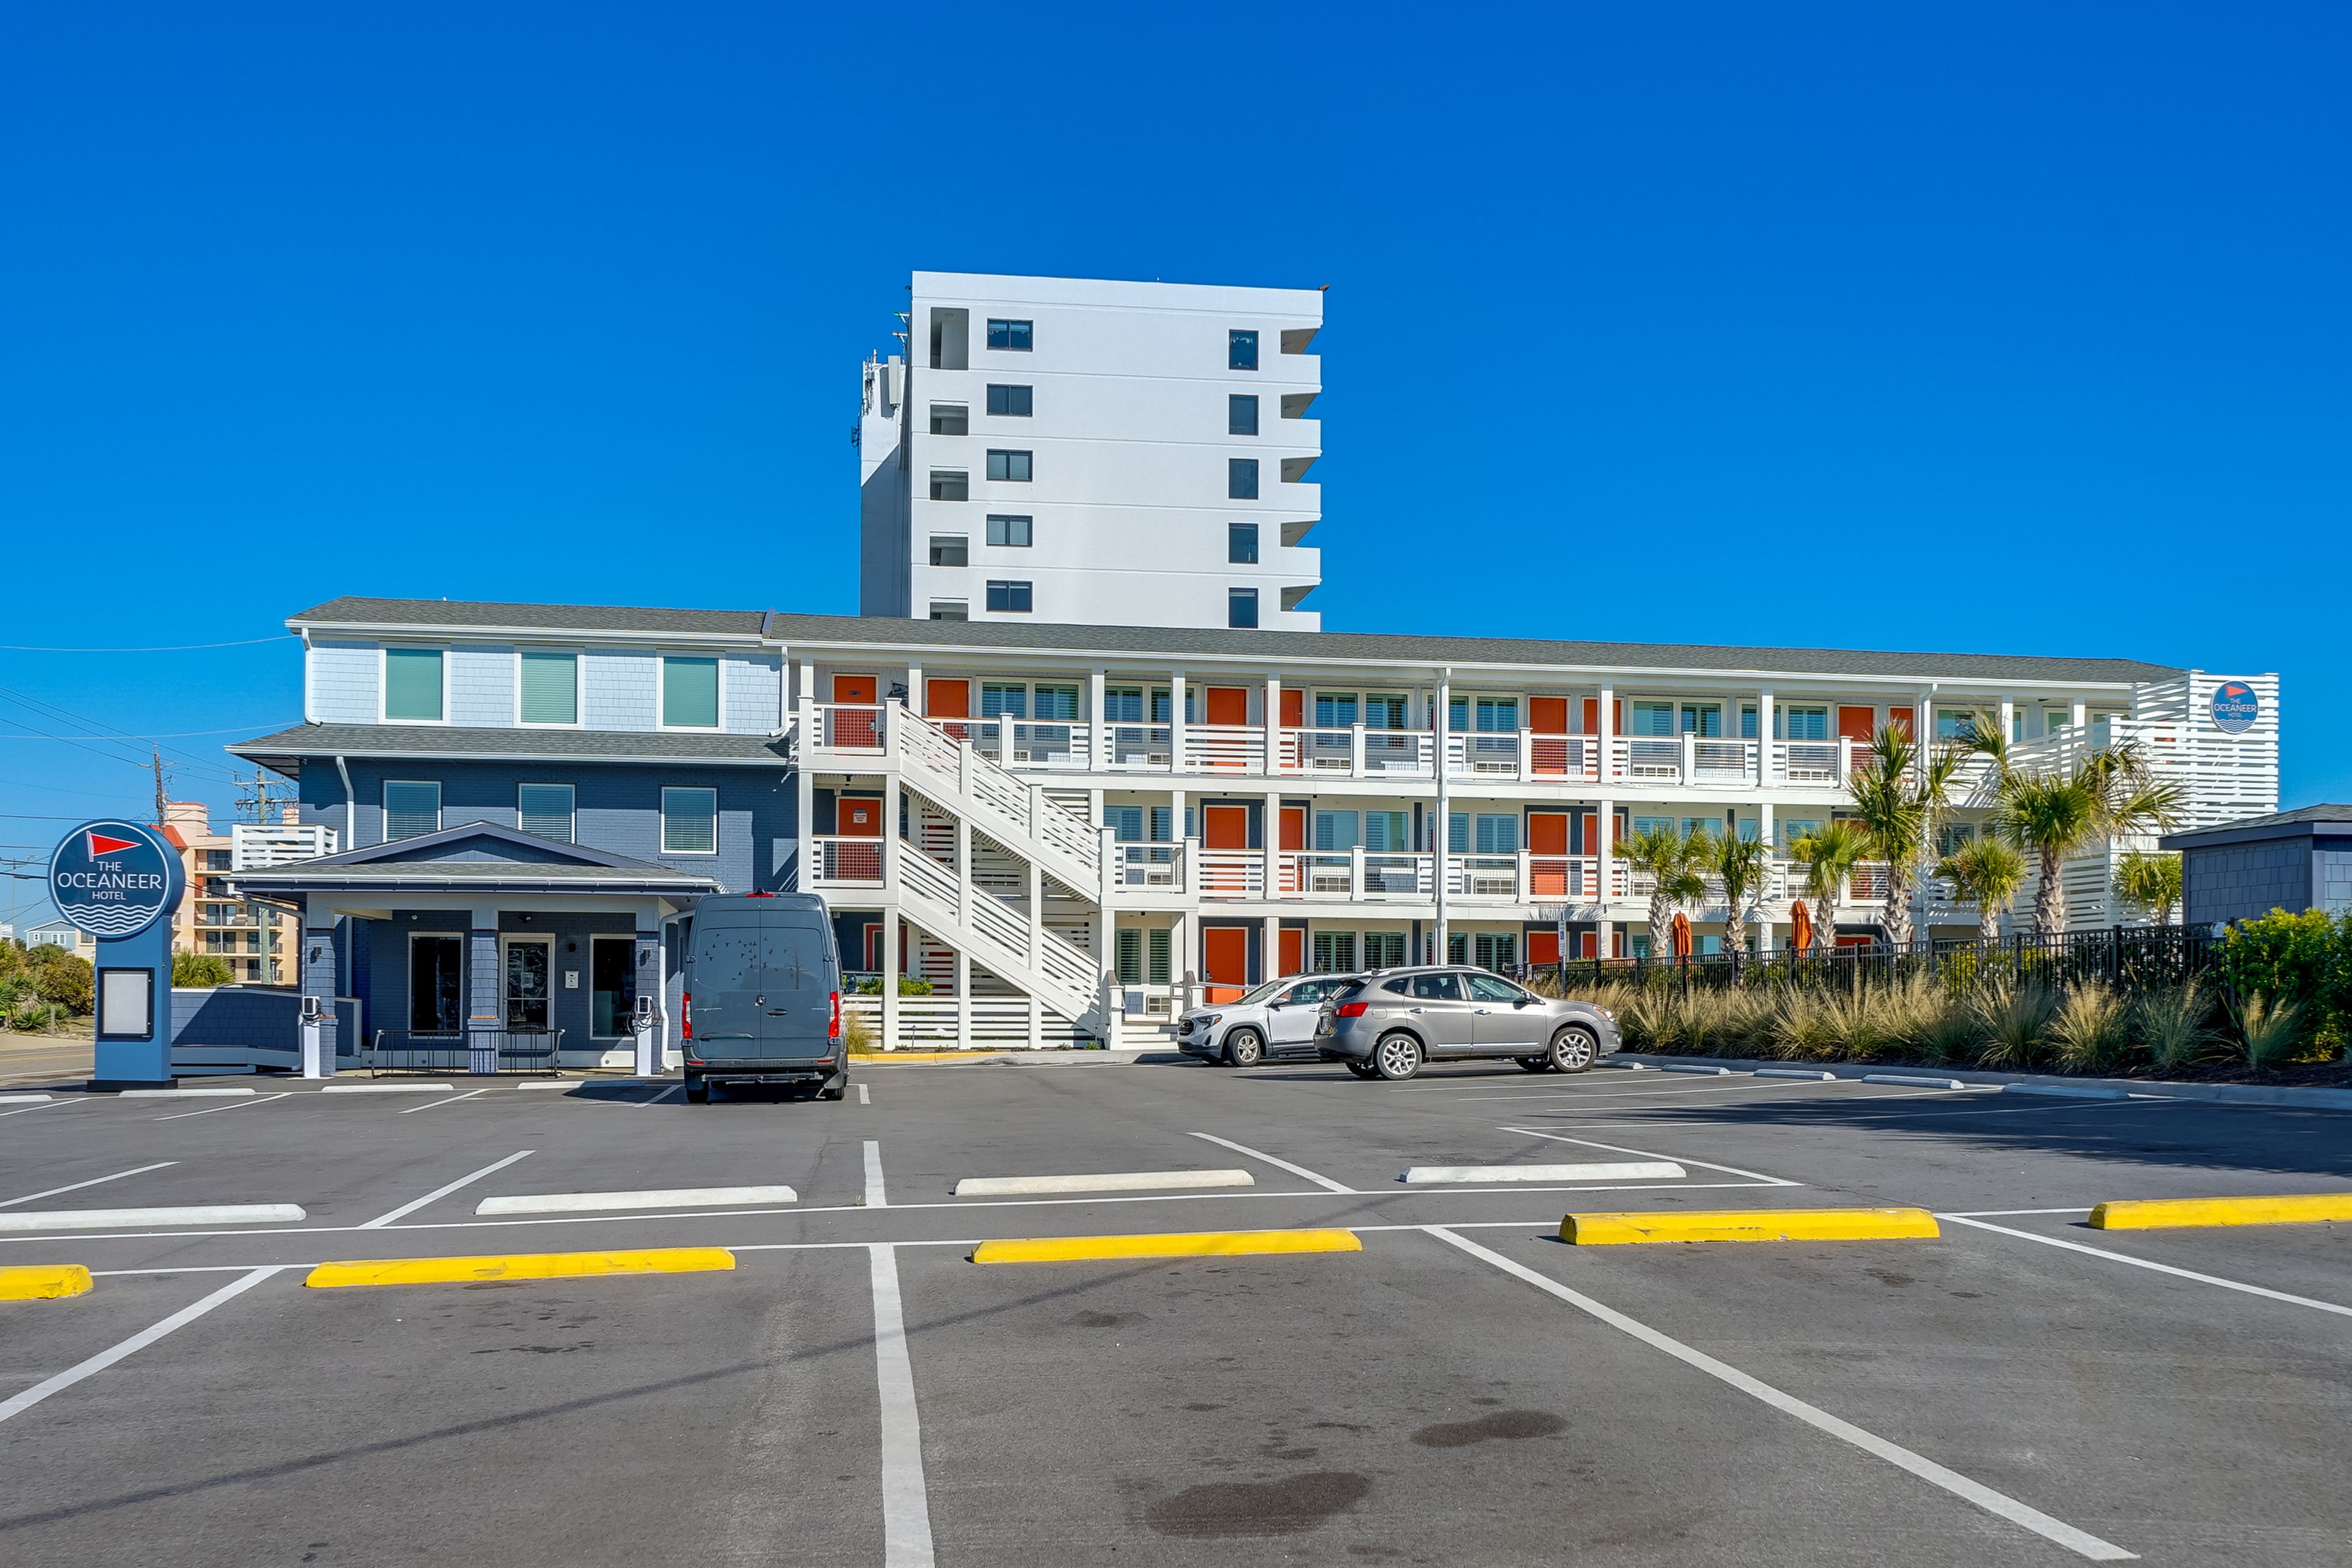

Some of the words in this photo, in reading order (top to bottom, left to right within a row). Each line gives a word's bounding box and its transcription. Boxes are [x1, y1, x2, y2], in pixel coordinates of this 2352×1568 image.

[2214, 703, 2256, 712] OCEANEER
[97, 861, 123, 872] THE
[57, 872, 162, 889] OCEANEER
[92, 891, 126, 900] HOTEL
